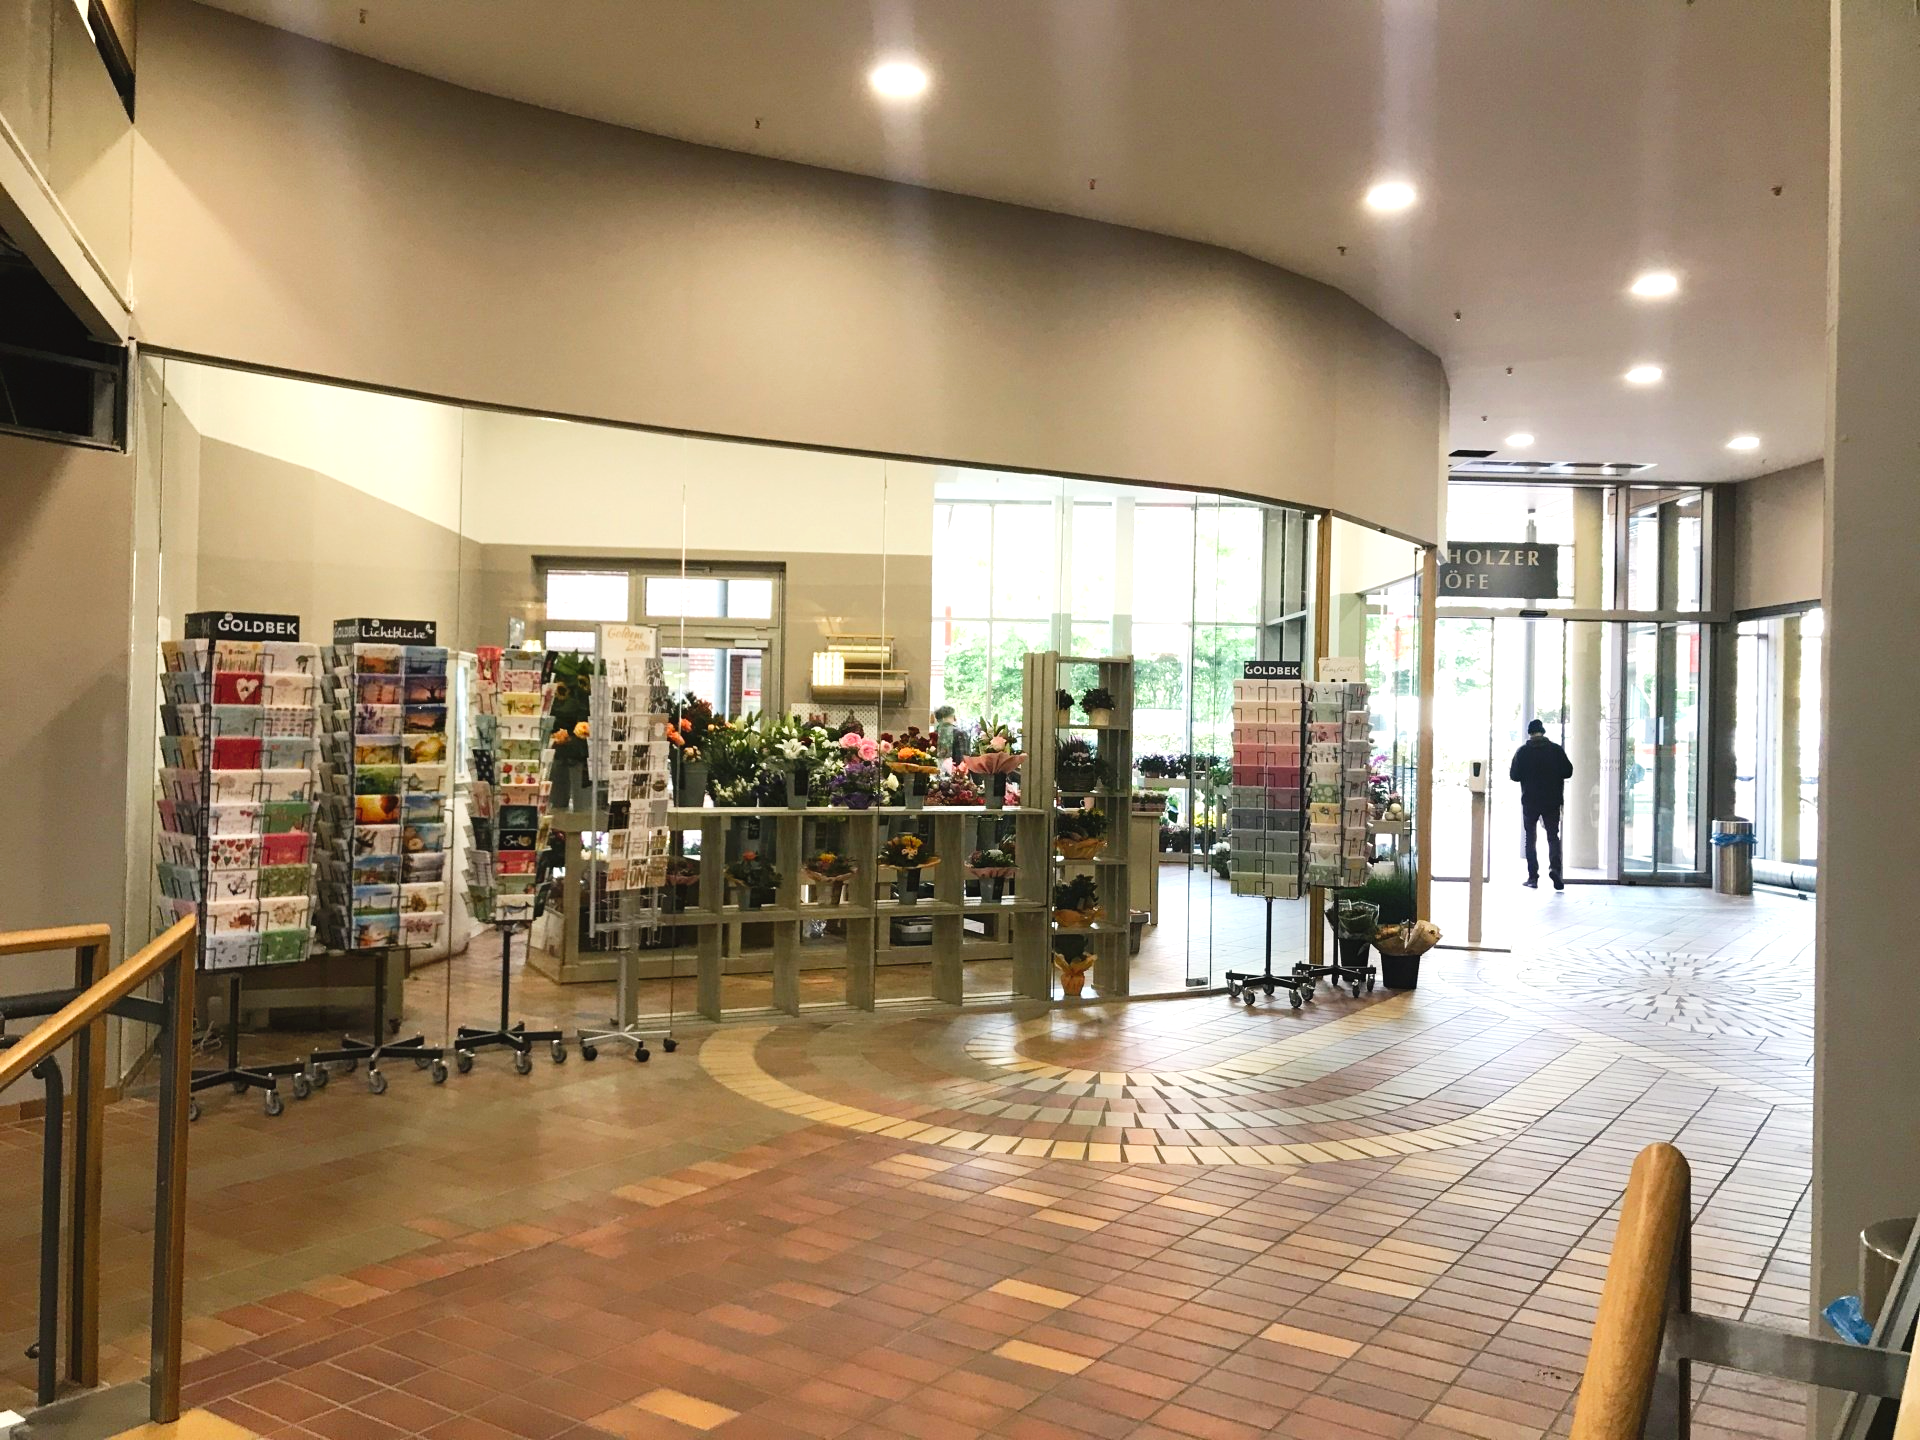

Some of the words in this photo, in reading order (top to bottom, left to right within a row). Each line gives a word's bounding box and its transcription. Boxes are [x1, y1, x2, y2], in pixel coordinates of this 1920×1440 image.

[1447, 549, 1540, 567] HOLZER
[1445, 570, 1489, 590] ÖFE
[218, 618, 297, 635] GOLDBEK
[362, 625, 428, 639] Lichtblicke
[607, 626, 644, 640] Goldene
[1245, 665, 1300, 676] GOLDBEK
